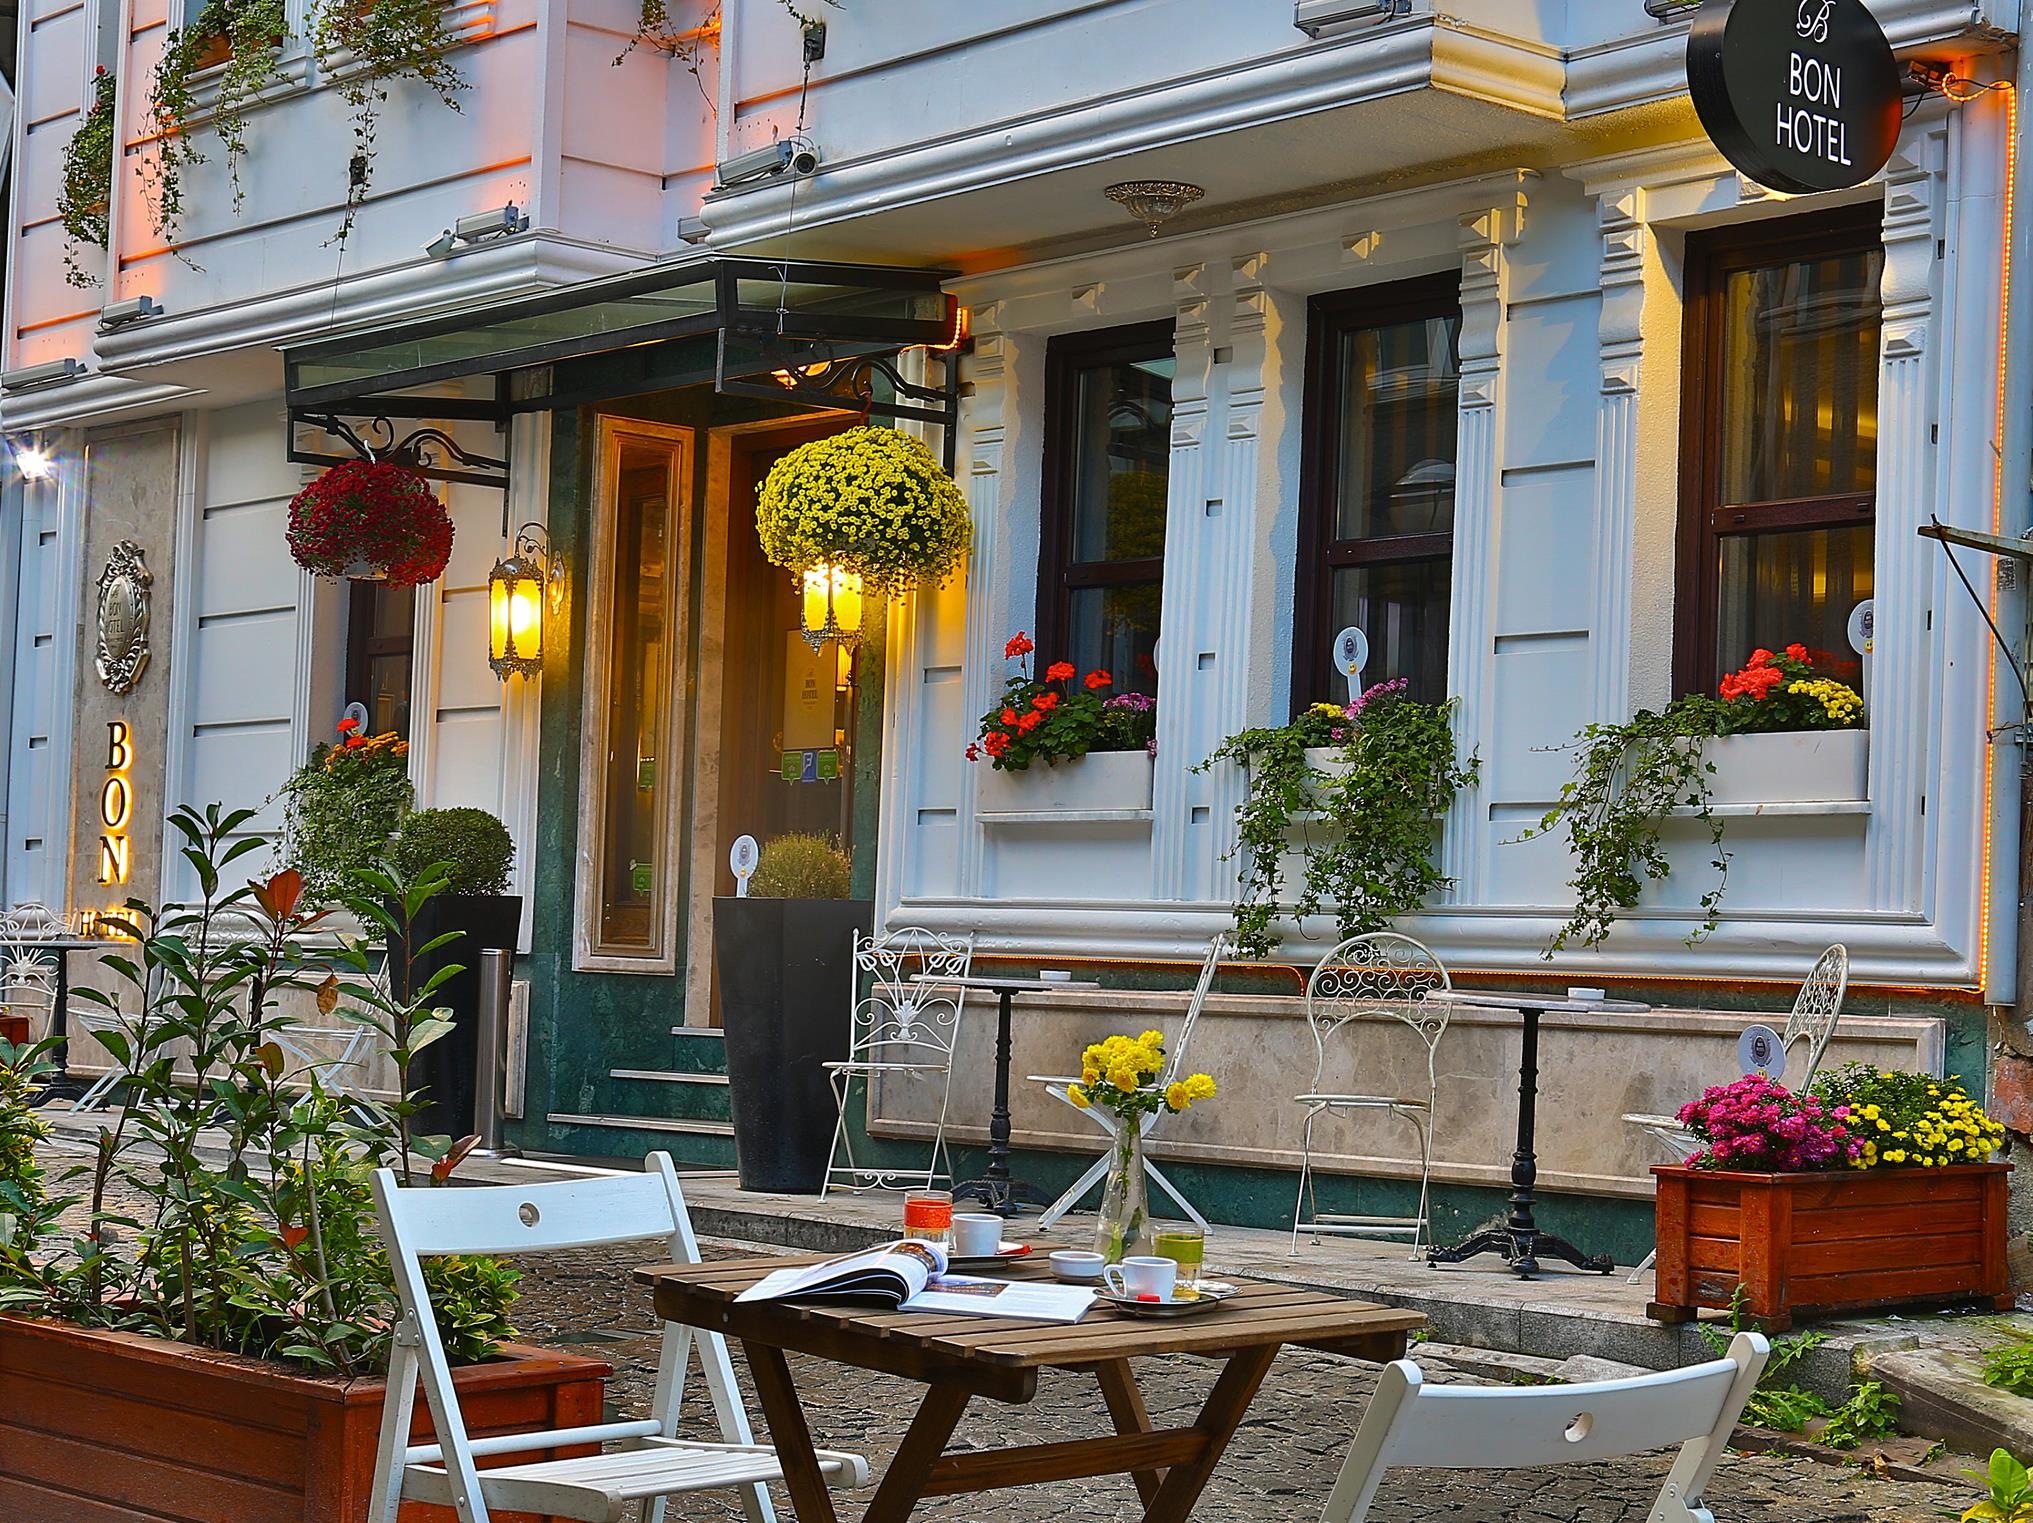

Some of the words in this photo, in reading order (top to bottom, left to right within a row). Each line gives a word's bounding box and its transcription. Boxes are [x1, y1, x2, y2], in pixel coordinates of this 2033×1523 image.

[1789, 52, 1841, 109] BON
[1776, 102, 1852, 166] HOTEL
[98, 721, 130, 884] BON
